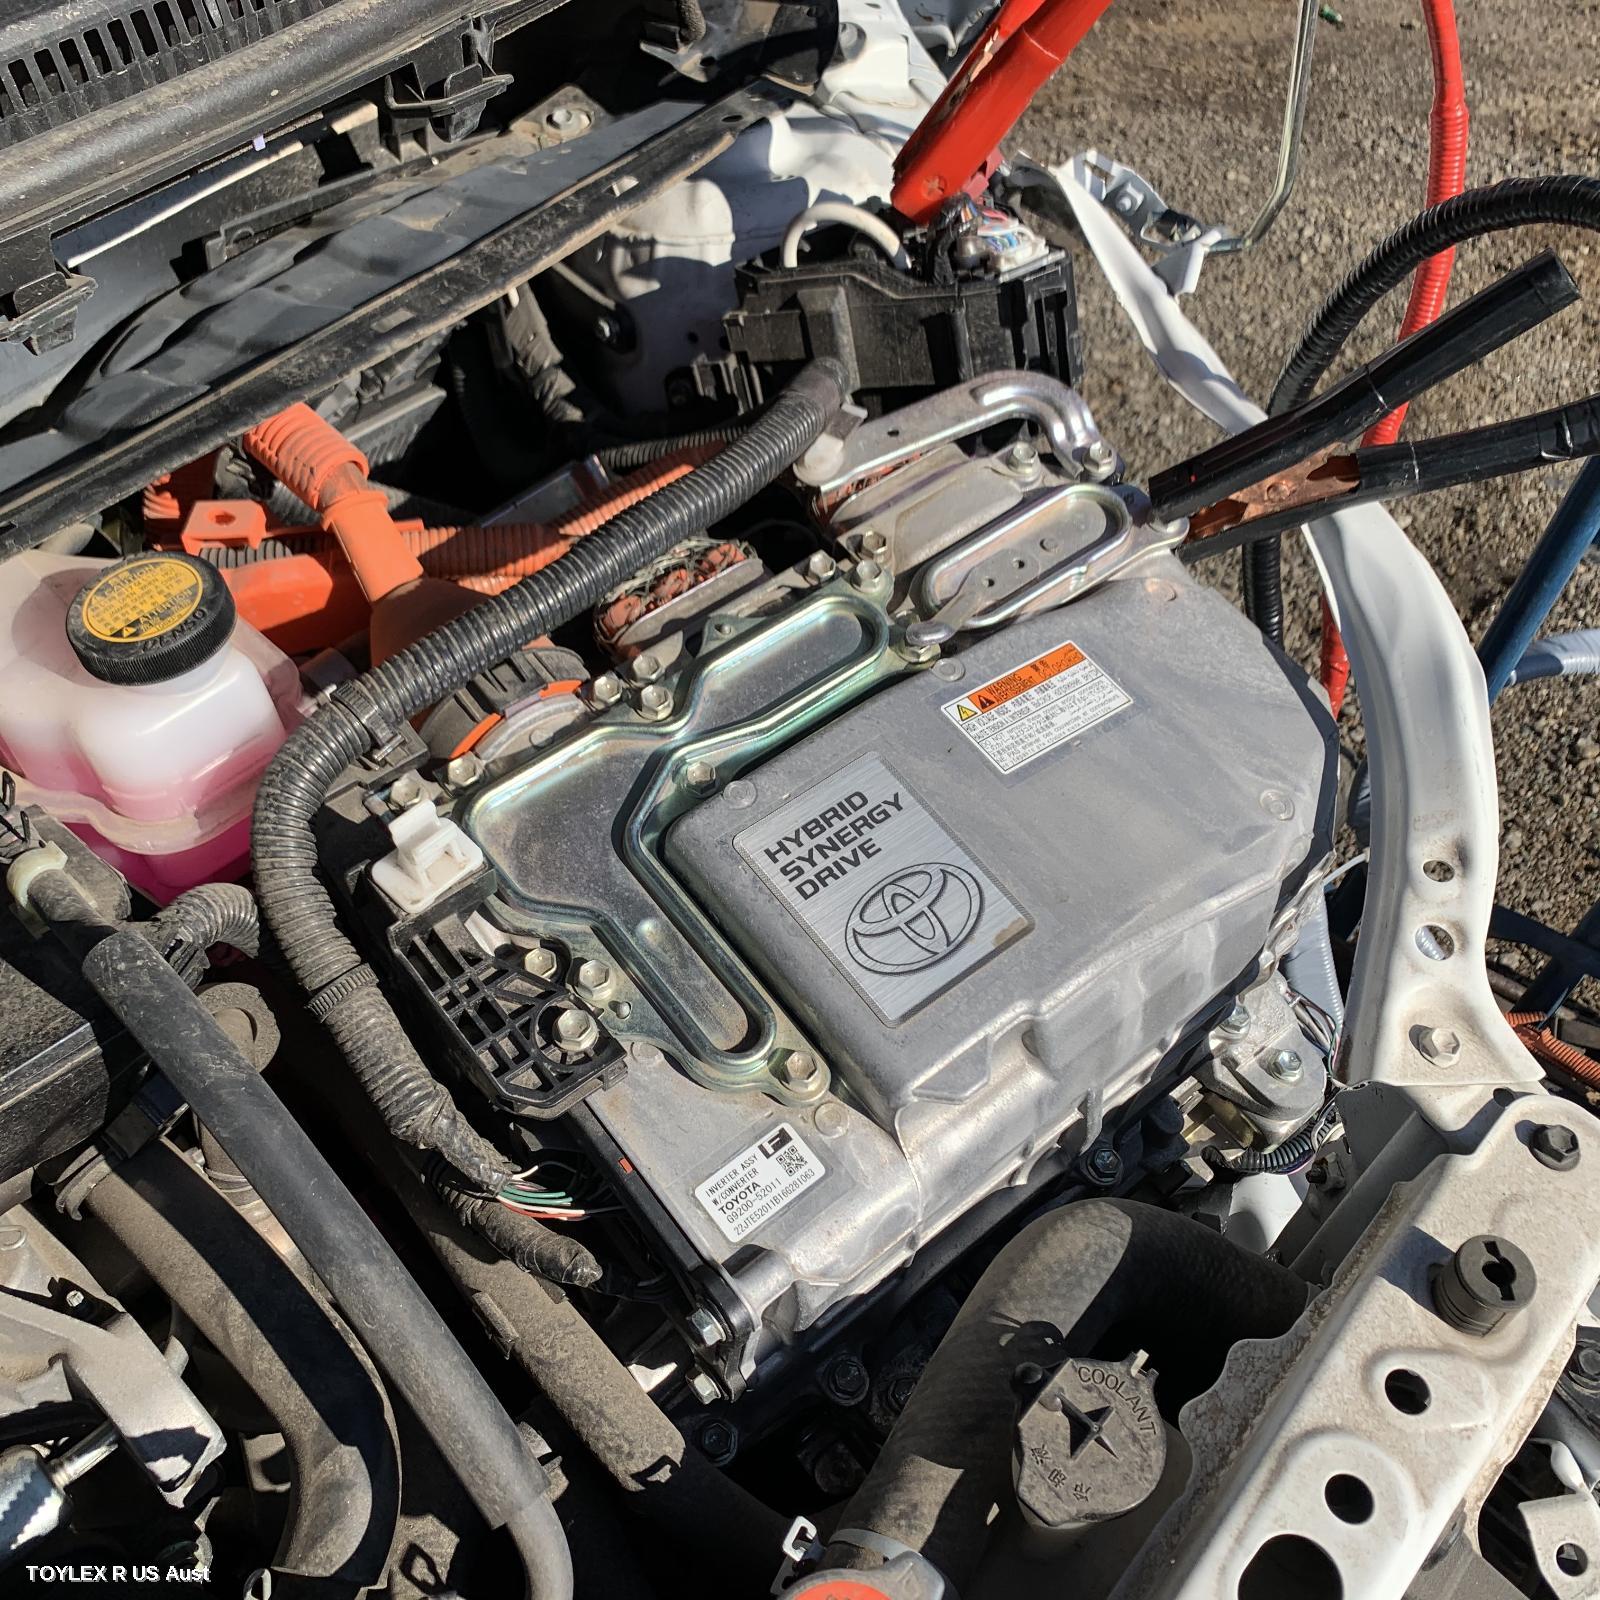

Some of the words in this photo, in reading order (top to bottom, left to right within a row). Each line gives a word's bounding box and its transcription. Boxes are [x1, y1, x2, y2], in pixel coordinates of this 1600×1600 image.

[984, 672, 1022, 695] WARNING
[763, 790, 869, 864] HYBRID
[779, 792, 904, 883] SYNERGY
[794, 837, 882, 901] DRIVE
[705, 1169, 740, 1198] INVERTER
[741, 1153, 760, 1171] ASSY
[712, 1168, 760, 1206] W/CONVERTER
[718, 1181, 762, 1215] TOYOTA
[727, 1178, 782, 1224] G9200-52011
[1077, 1365, 1158, 1436] COOLANT
